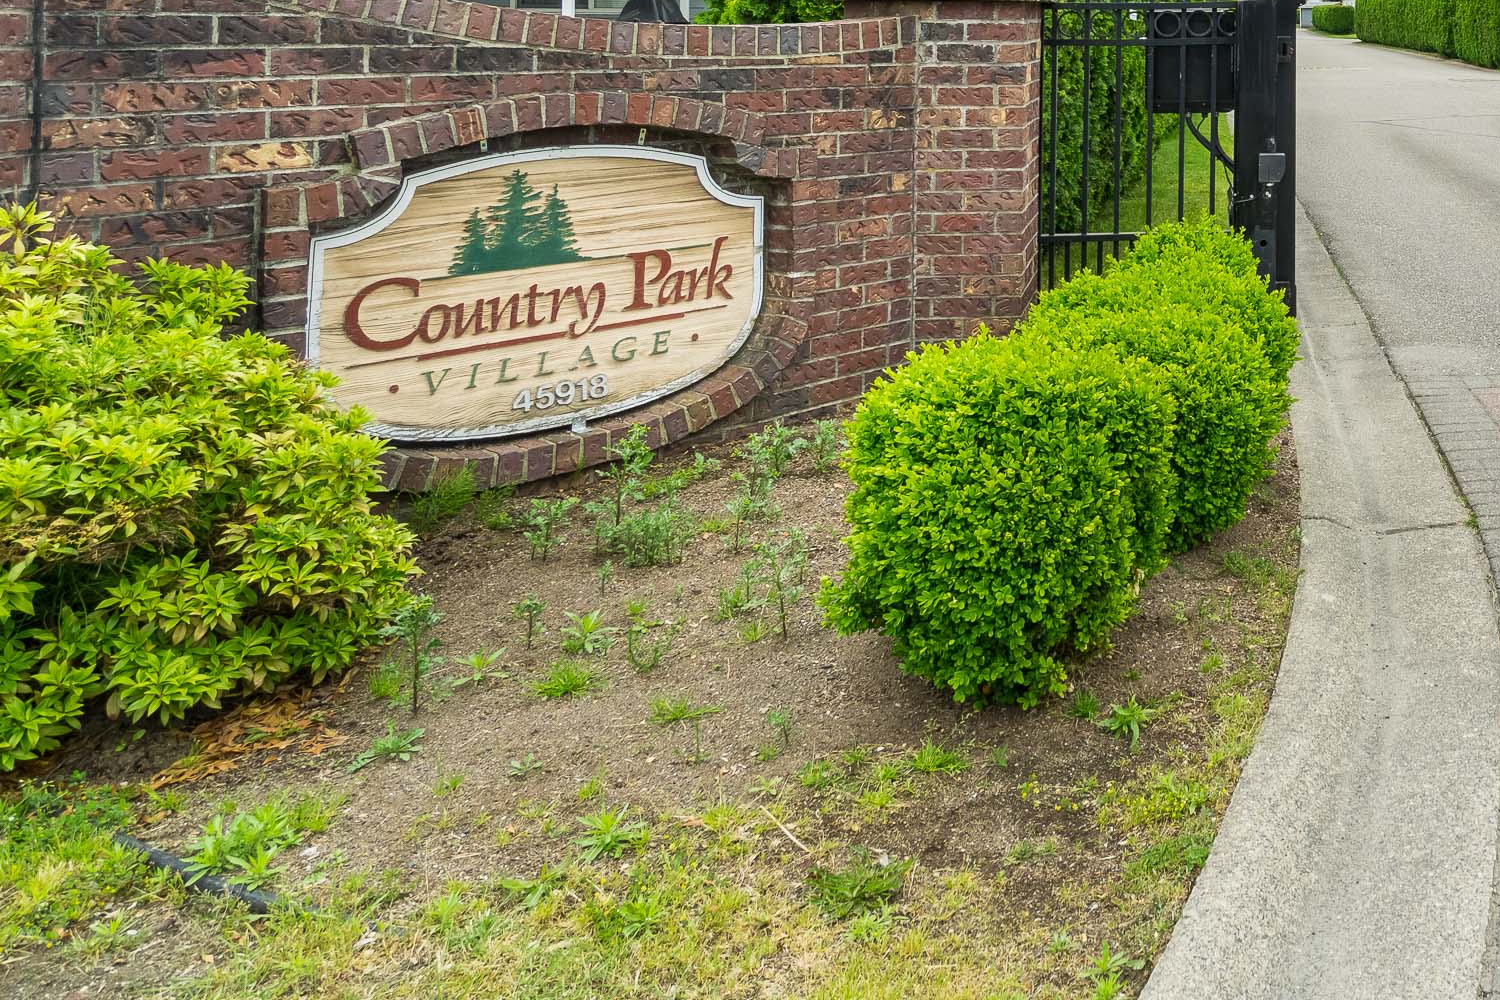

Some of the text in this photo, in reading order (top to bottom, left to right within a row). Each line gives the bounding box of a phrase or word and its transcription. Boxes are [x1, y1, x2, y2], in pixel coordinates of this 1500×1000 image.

[344, 236, 733, 352] Country Park
[421, 330, 672, 396] VILLAGE
[511, 374, 609, 412] 45918
